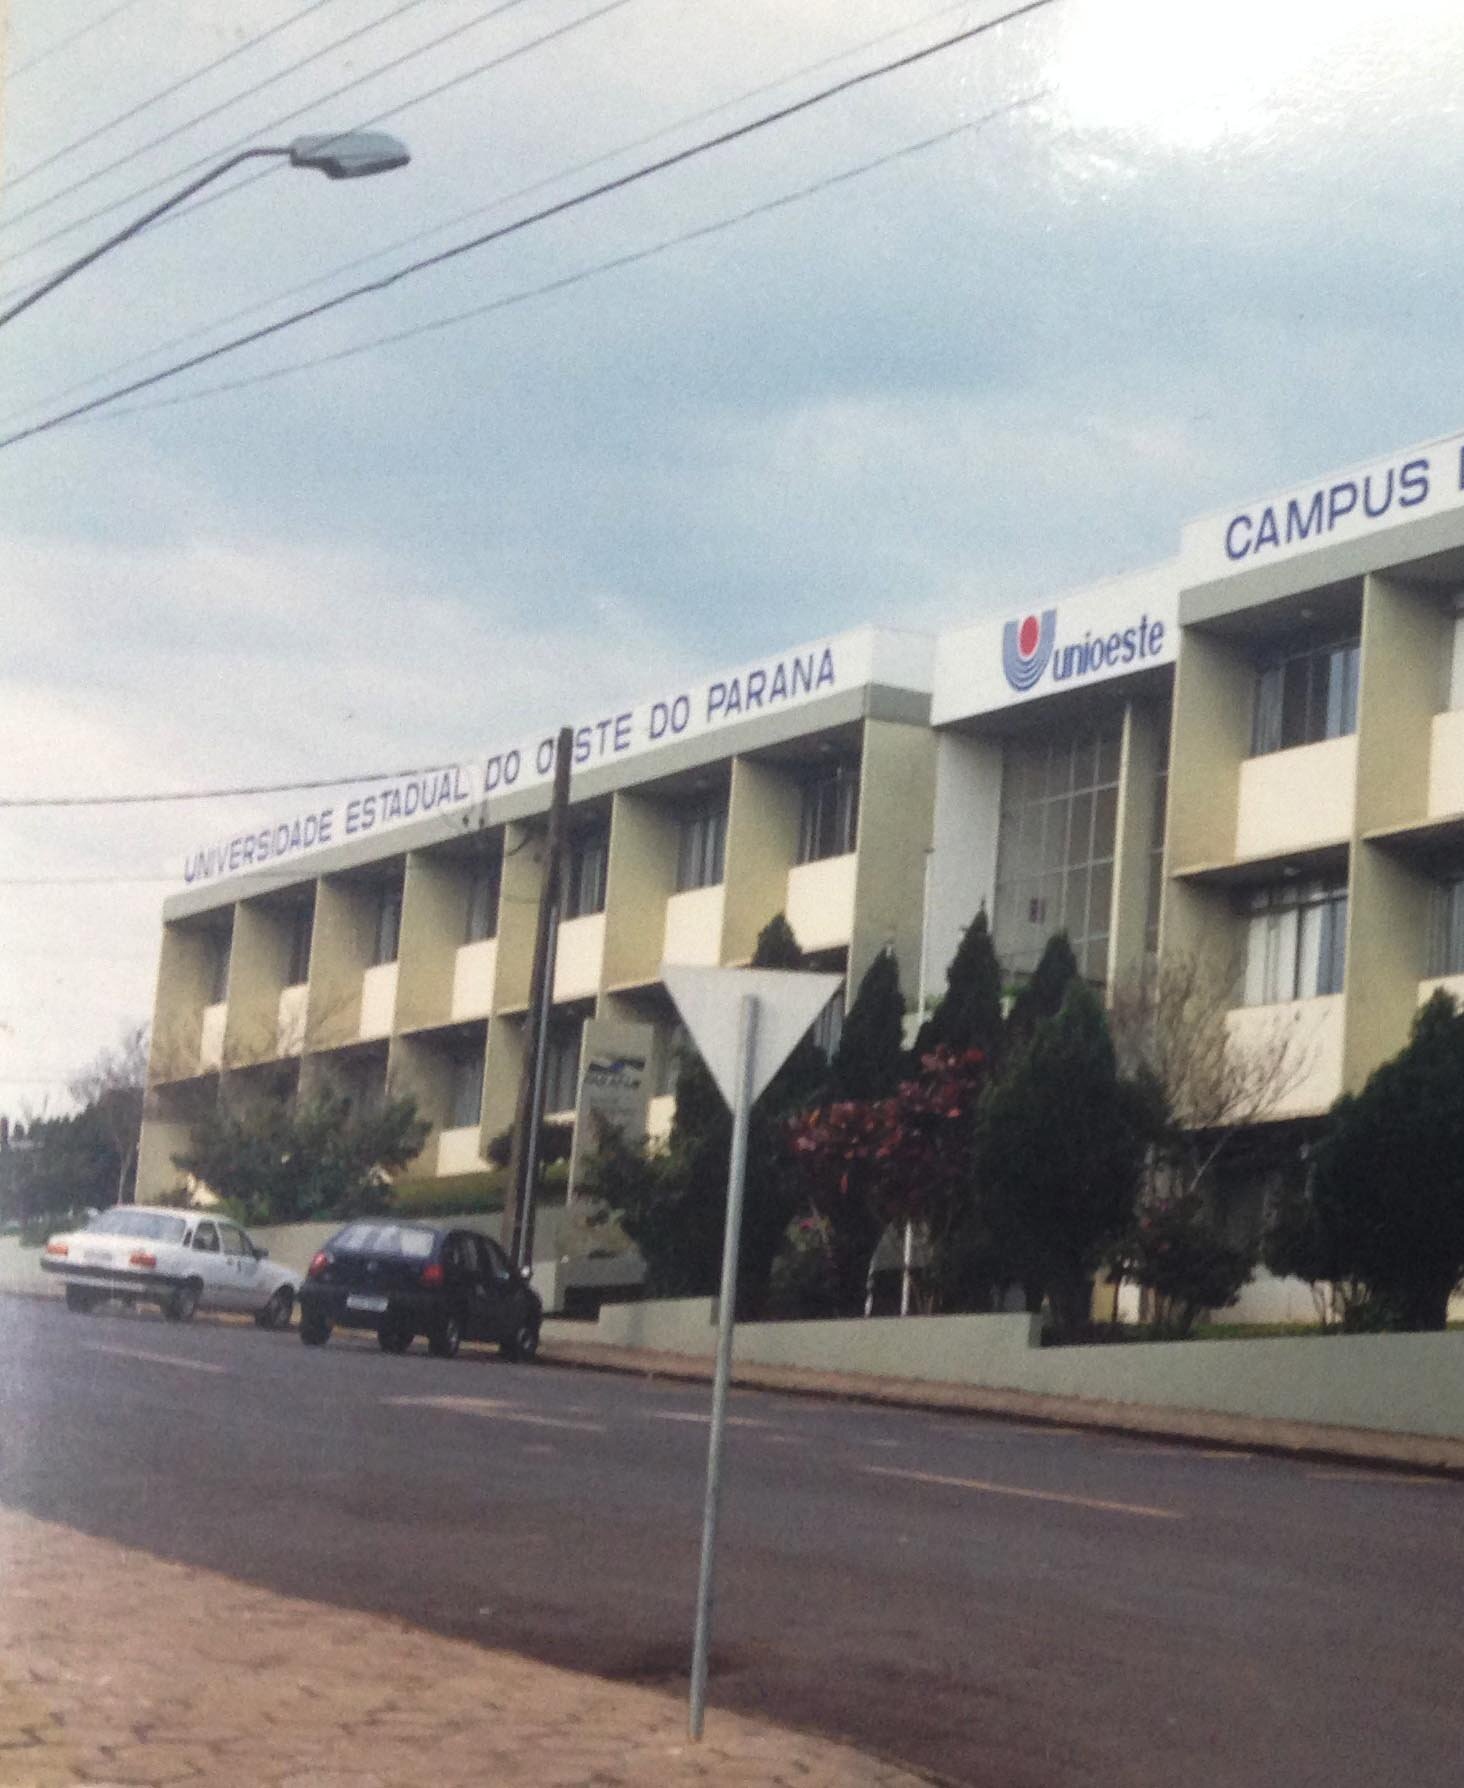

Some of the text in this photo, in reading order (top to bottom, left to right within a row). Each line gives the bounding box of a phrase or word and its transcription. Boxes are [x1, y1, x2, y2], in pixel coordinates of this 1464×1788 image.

[1224, 457, 1430, 561] CAMPUS
[1053, 614, 1165, 682] unioeste
[184, 808, 334, 883] UNIVERSIDADE
[345, 767, 469, 834] ESTADUAL
[484, 749, 521, 792] DO
[536, 712, 632, 775] OSTE
[650, 694, 690, 740] DO
